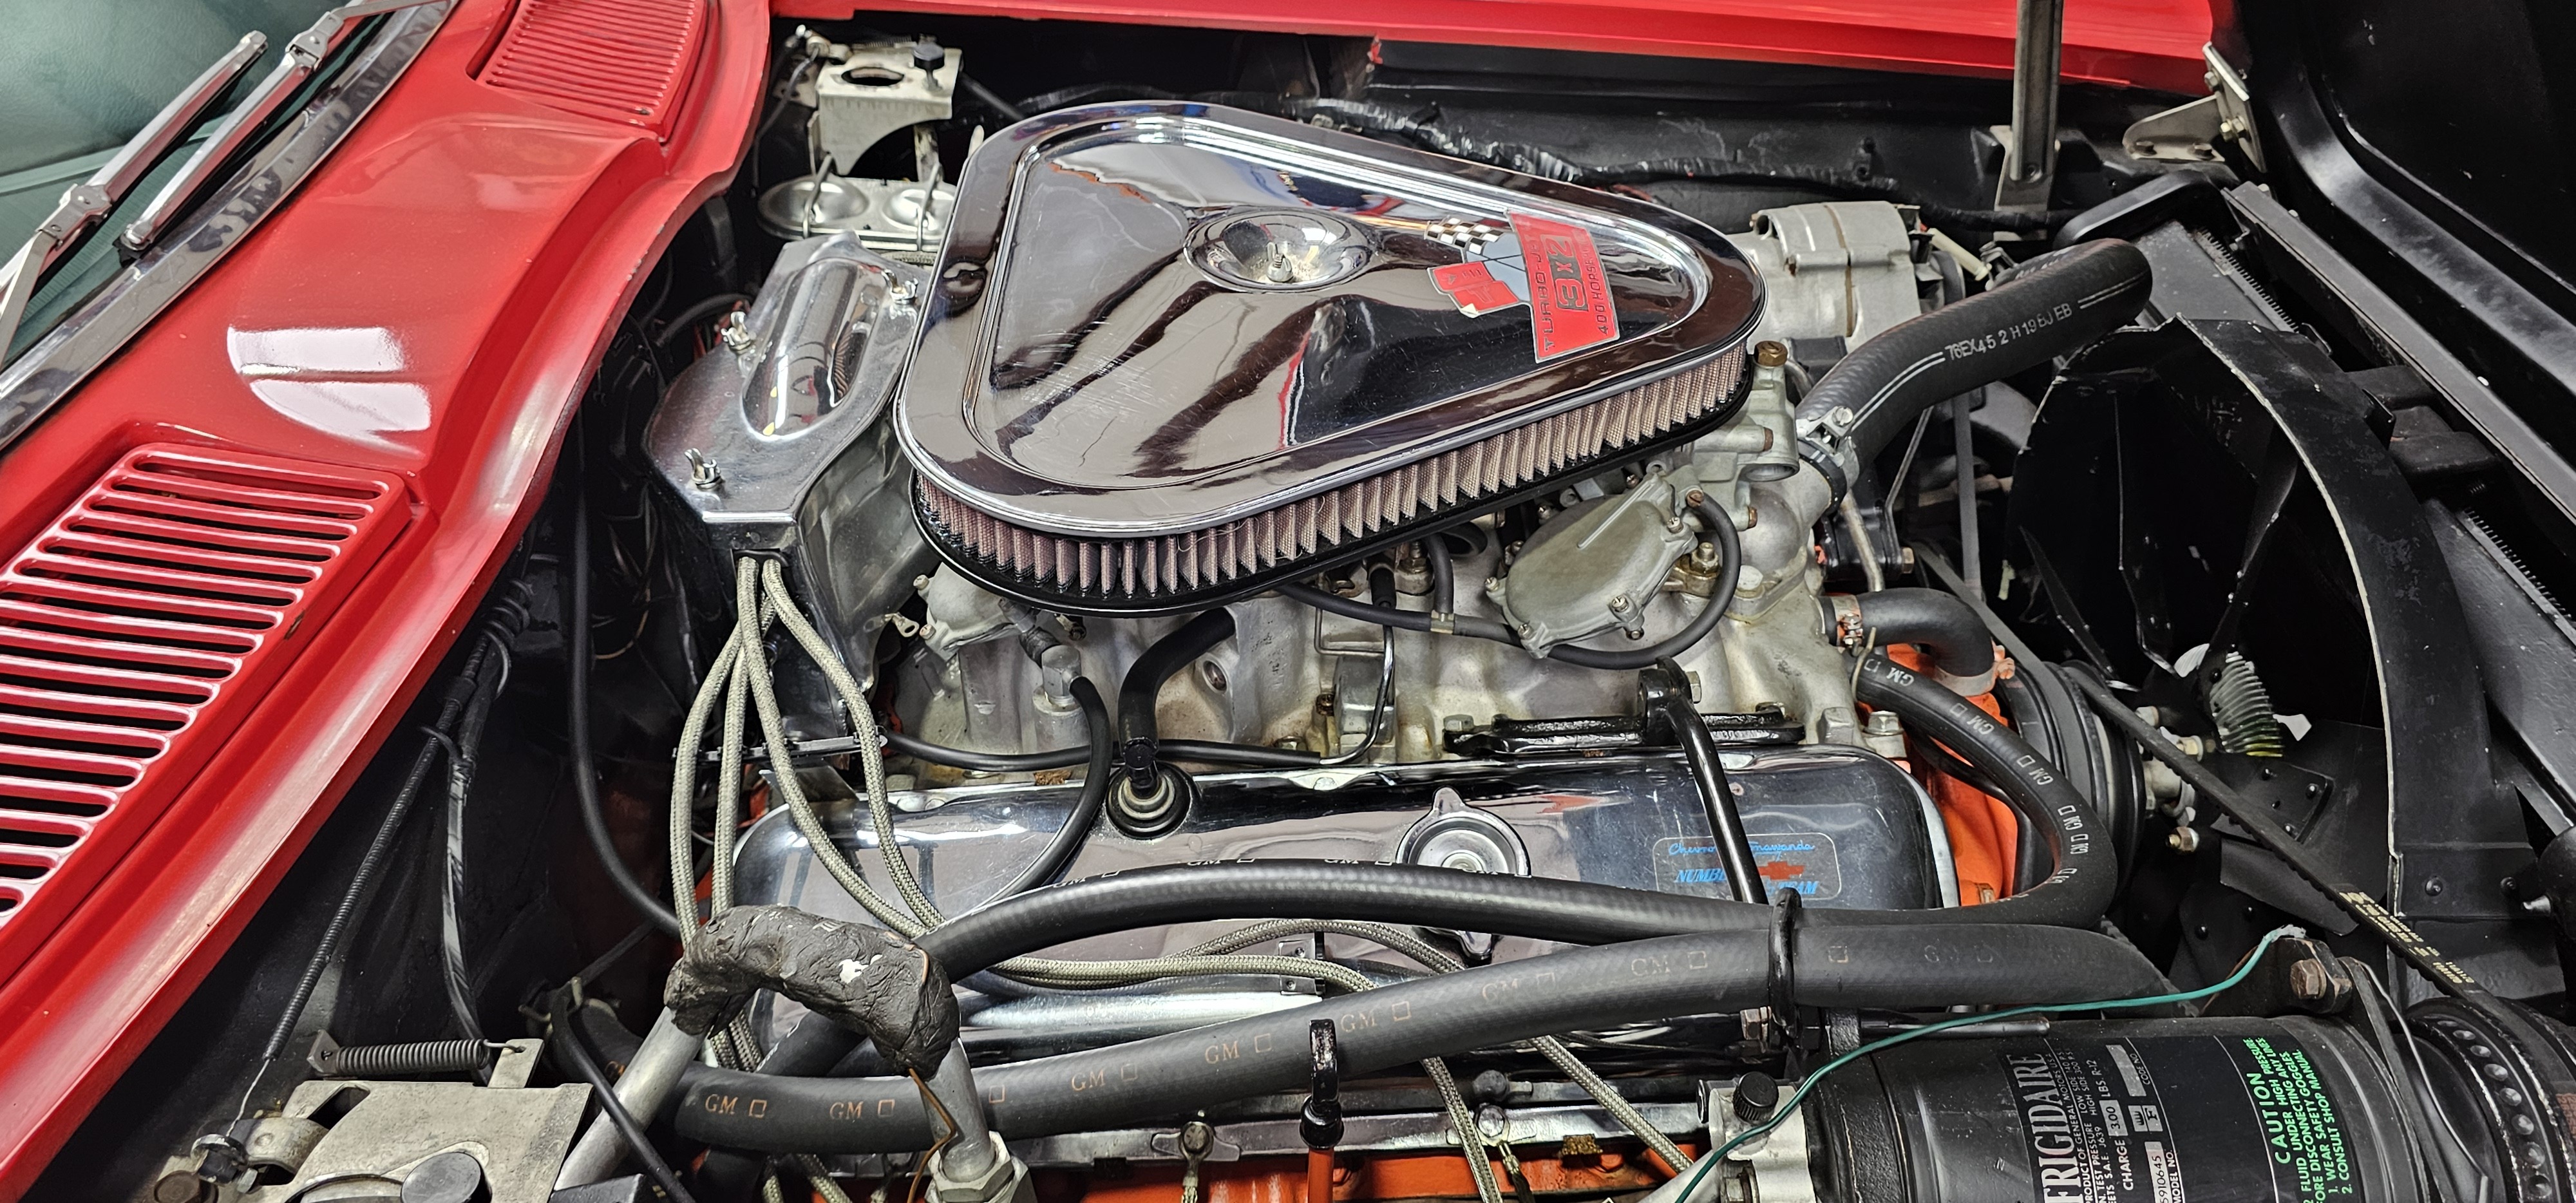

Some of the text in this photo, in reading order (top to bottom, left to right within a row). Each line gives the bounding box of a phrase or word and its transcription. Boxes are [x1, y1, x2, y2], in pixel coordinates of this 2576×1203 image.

[1573, 230, 1609, 336] 400 HORSEP
[1886, 667, 1915, 687] GM
[1966, 715, 1994, 735] GM
[2029, 767, 2054, 785] GM
[1669, 842, 1716, 856] Chevro
[1482, 978, 1520, 1003] GM
[1340, 1011, 1376, 1033] GM
[1204, 1043, 1240, 1065] GM
[2071, 1061, 2083, 1074] 300
[2087, 1059, 2102, 1075] R-12
[2136, 1066, 2150, 1085] CODE
[2270, 1059, 2289, 1078] ANY
[1071, 1070, 1105, 1092] GM
[2053, 1070, 2071, 1101] MOTORS
[2069, 1076, 2081, 1092] SIDE
[2078, 1076, 2090, 1092] SIDE
[2076, 1094, 2088, 1113] LOW
[2268, 1079, 2289, 1106] HIGH
[705, 1095, 736, 1115] GM
[829, 1101, 862, 1121] GM
[2085, 1094, 2098, 1115] HIGH
[2007, 1052, 2084, 1203] FRIGIDAIRE
[2067, 1104, 2083, 1144] GENERAL
[2106, 1106, 2121, 1130] 3.00
[2246, 1073, 2291, 1164] CAUTION
[2282, 1080, 2321, 1171] DISCONNECTING
[2292, 1049, 2353, 1194] 2. CONSULT SHOP MANUAL.
[2304, 1099, 2327, 1139] SAFETY
[2094, 1126, 2107, 1148] J639
[2282, 1112, 2303, 1151] UNDER
[2077, 1147, 2087, 1160] OF
[2084, 1122, 2101, 1166] PRESSURE
[2114, 1139, 2134, 1191] CHARGE
[2319, 1144, 2336, 1181] WEAR
[2094, 1170, 2105, 1191] TEST
[2296, 1157, 2312, 1191] FLUID
[2313, 1176, 2326, 1203] ORE
